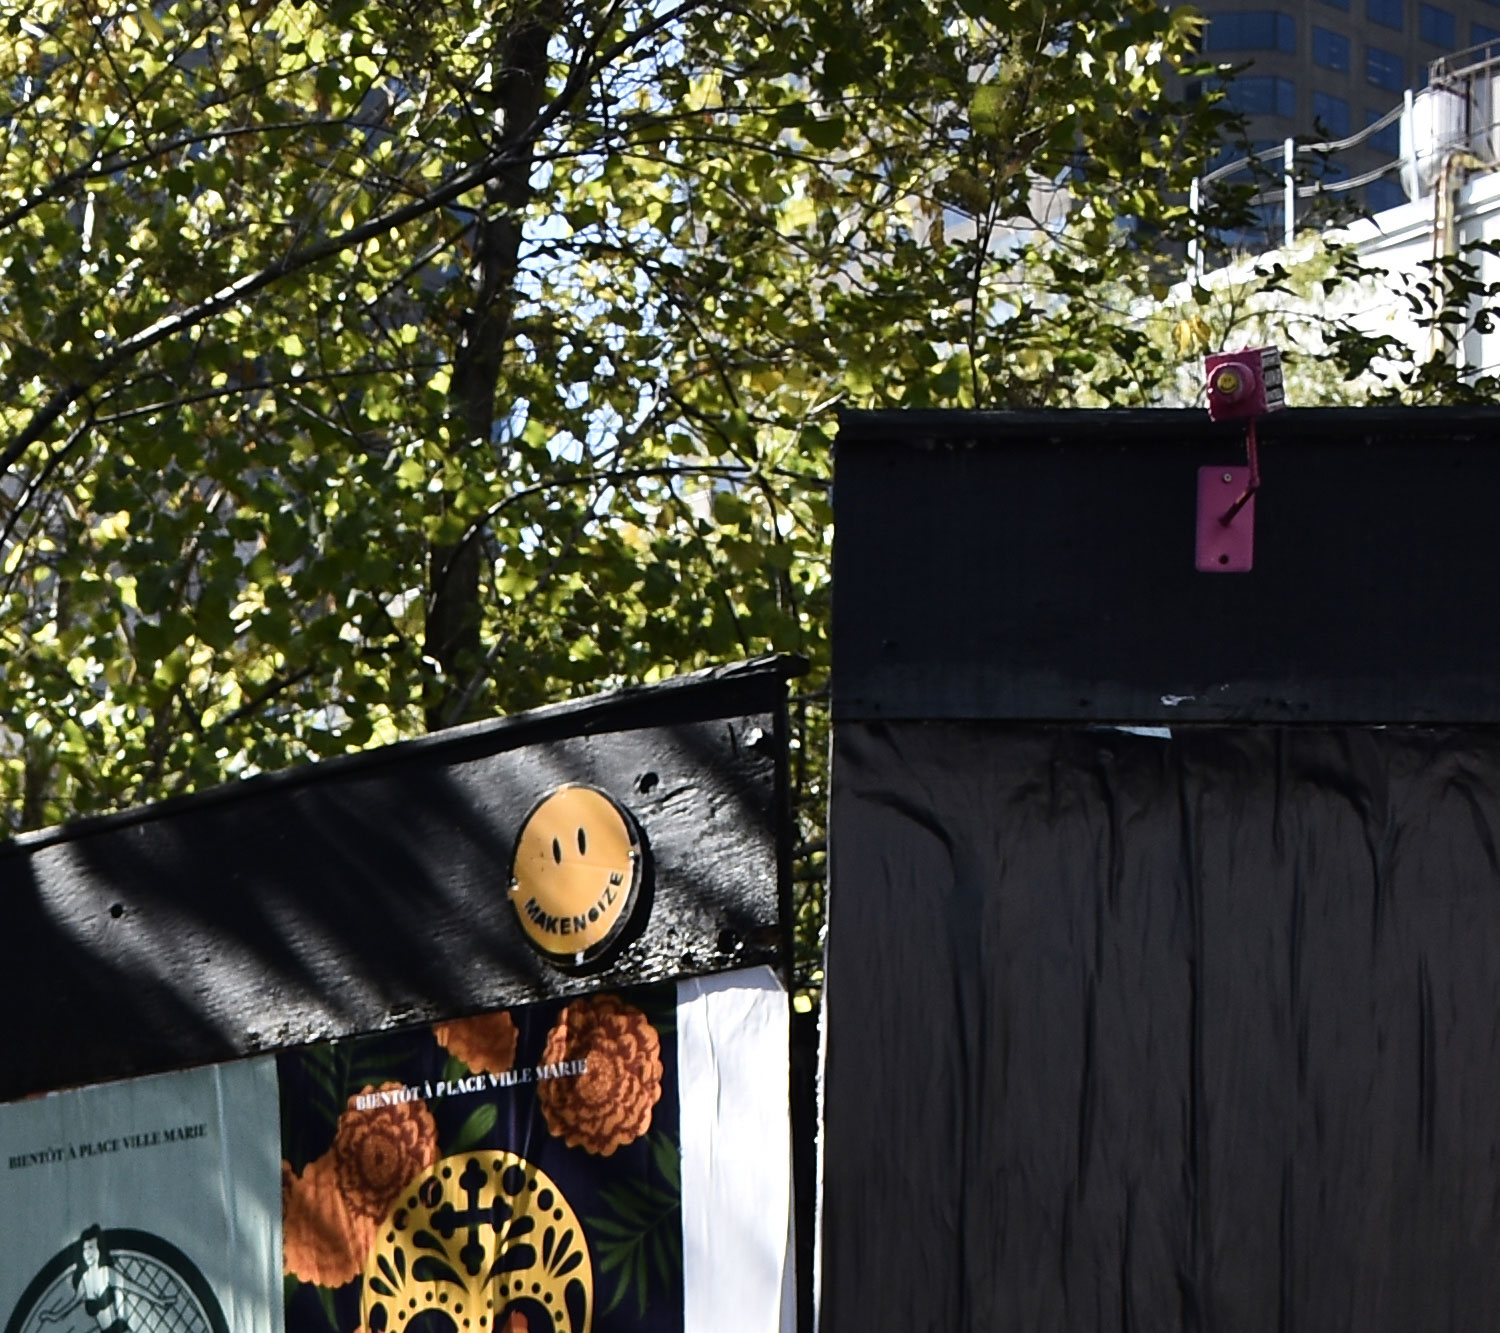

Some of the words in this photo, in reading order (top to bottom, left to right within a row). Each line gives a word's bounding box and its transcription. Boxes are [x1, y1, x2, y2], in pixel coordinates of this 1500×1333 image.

[355, 1084, 423, 1112] BIENTÔT
[423, 1079, 433, 1100] À
[436, 1074, 487, 1098] PLACE
[488, 1067, 533, 1089] VILLE
[535, 1058, 588, 1082] MARIE
[8, 1146, 64, 1170] BIENTÔT
[63, 1142, 78, 1161] À
[79, 1137, 120, 1158] PLACE
[122, 1131, 162, 1149] VILLE
[163, 1123, 208, 1143] MARIE
